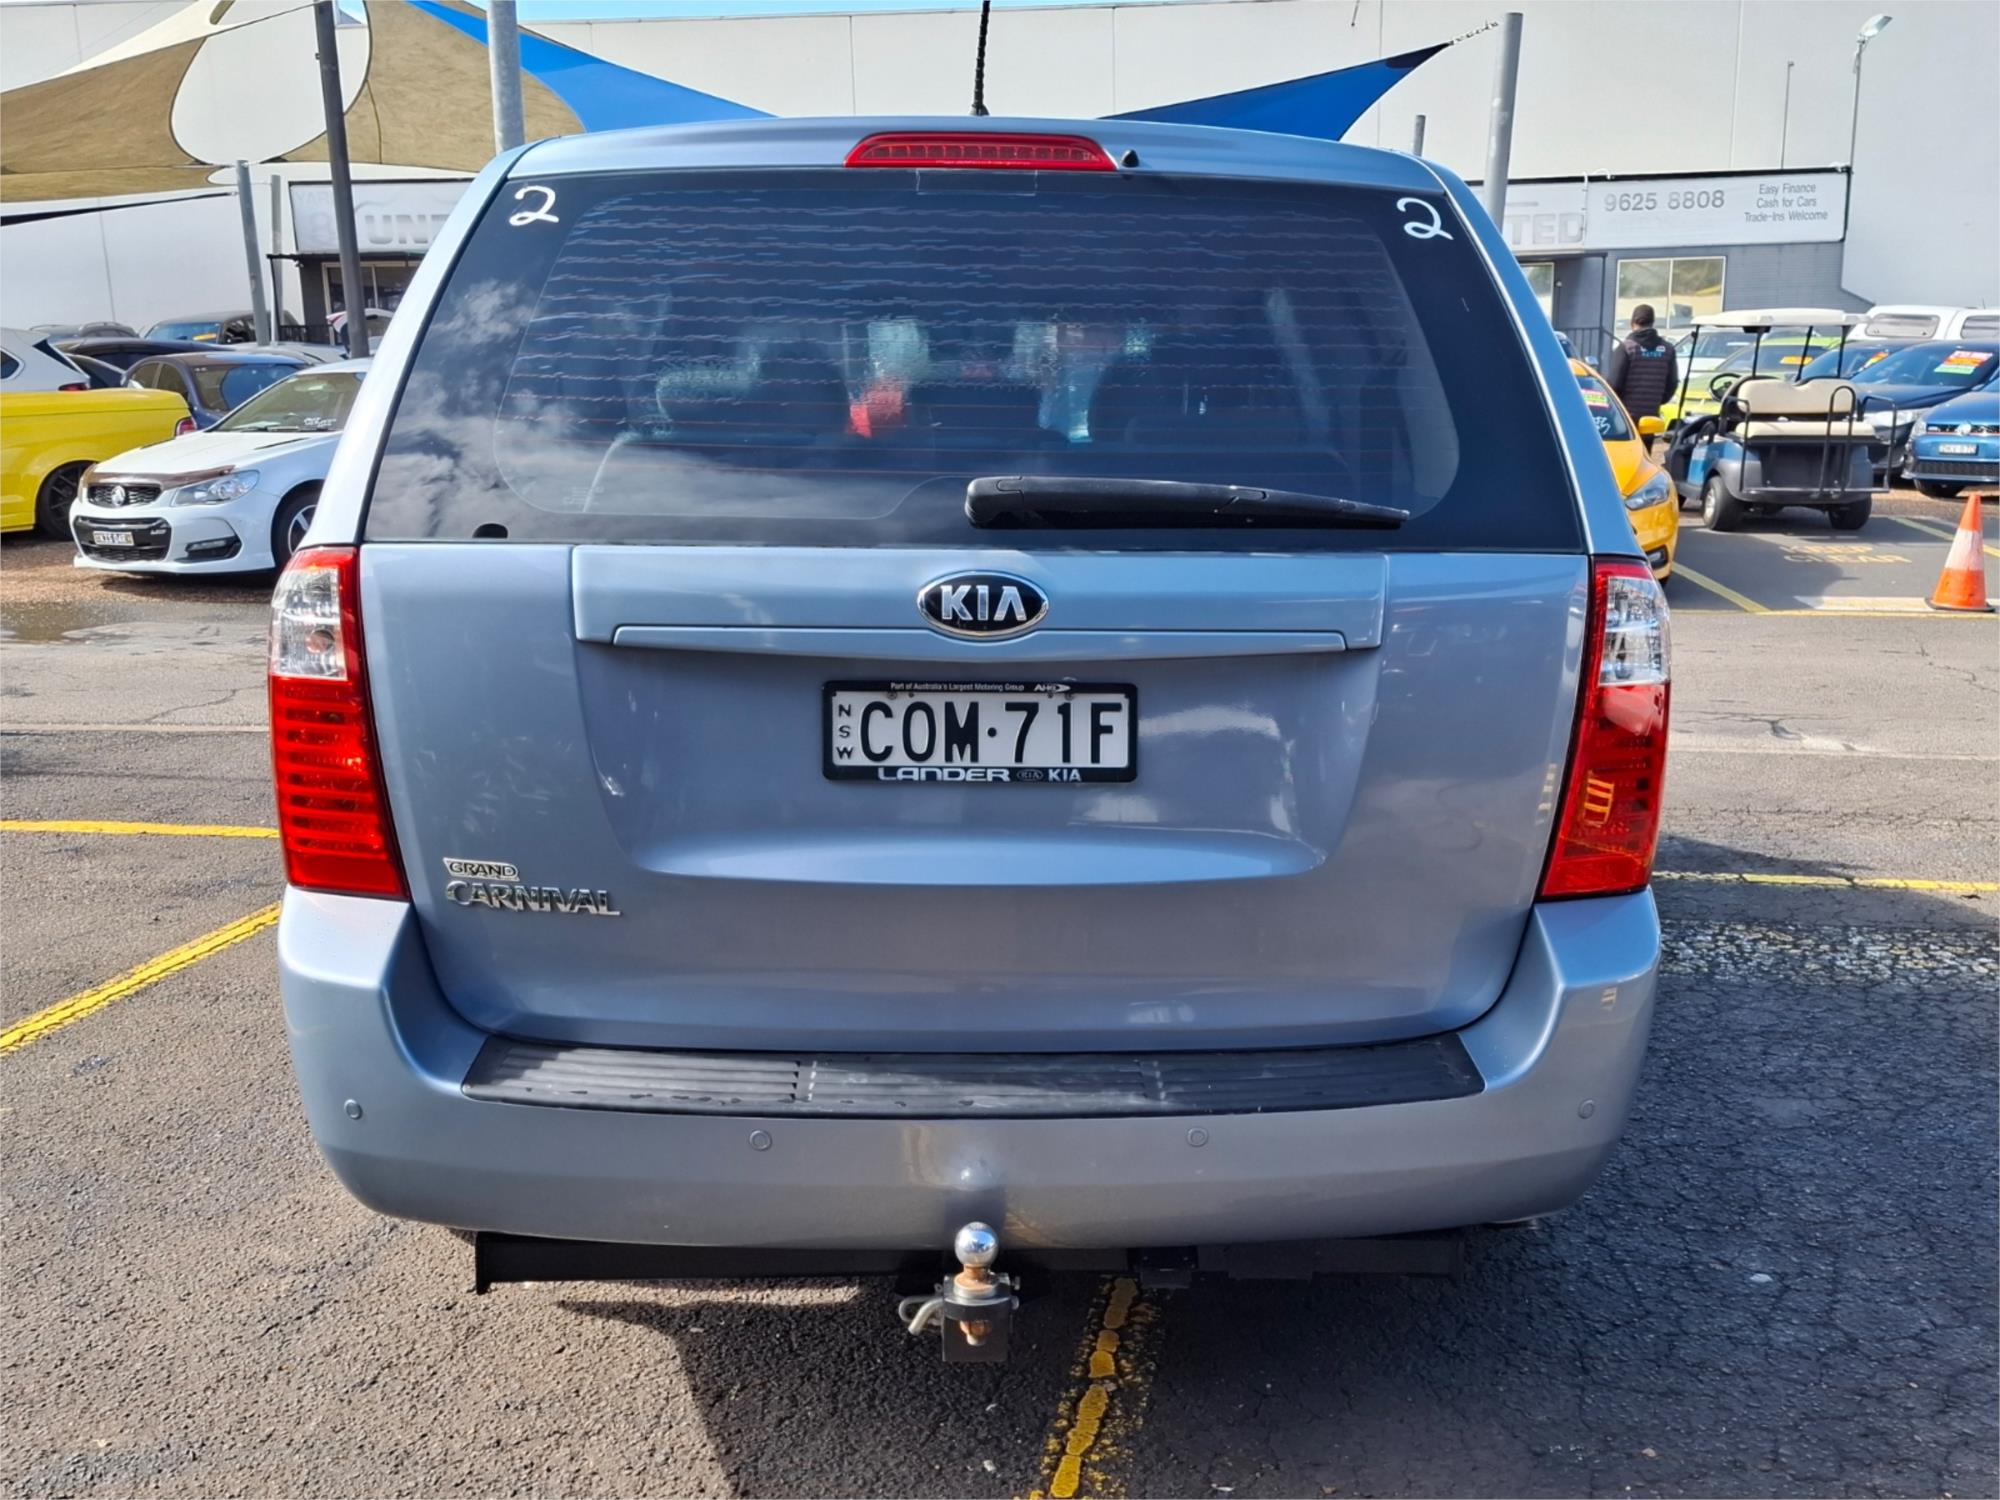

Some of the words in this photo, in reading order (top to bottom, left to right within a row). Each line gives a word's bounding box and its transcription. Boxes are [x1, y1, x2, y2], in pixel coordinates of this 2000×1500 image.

[1758, 184, 1780, 196] Easy
[1782, 182, 1817, 194] Finance
[508, 185, 560, 227] 2
[1604, 192, 1658, 213] 9625
[1667, 189, 1726, 210] 8808
[1756, 197, 1779, 209] Cash
[1781, 198, 1795, 208] for
[1797, 196, 1817, 208] Cars
[1744, 210, 1785, 223] Trade-Ins
[1788, 209, 1829, 221] Welcome
[940, 585, 1027, 621] KIA
[890, 682, 904, 690] Part
[905, 682, 912, 690] of
[913, 683, 947, 691] Australia's
[949, 683, 972, 692] Largest
[974, 684, 1003, 693] Motoring
[1004, 684, 1025, 693] Group
[877, 766, 1011, 782] LANDER
[1048, 768, 1082, 782] KIA
[449, 862, 517, 877] GRAND
[446, 880, 621, 916] CARNIVAL
